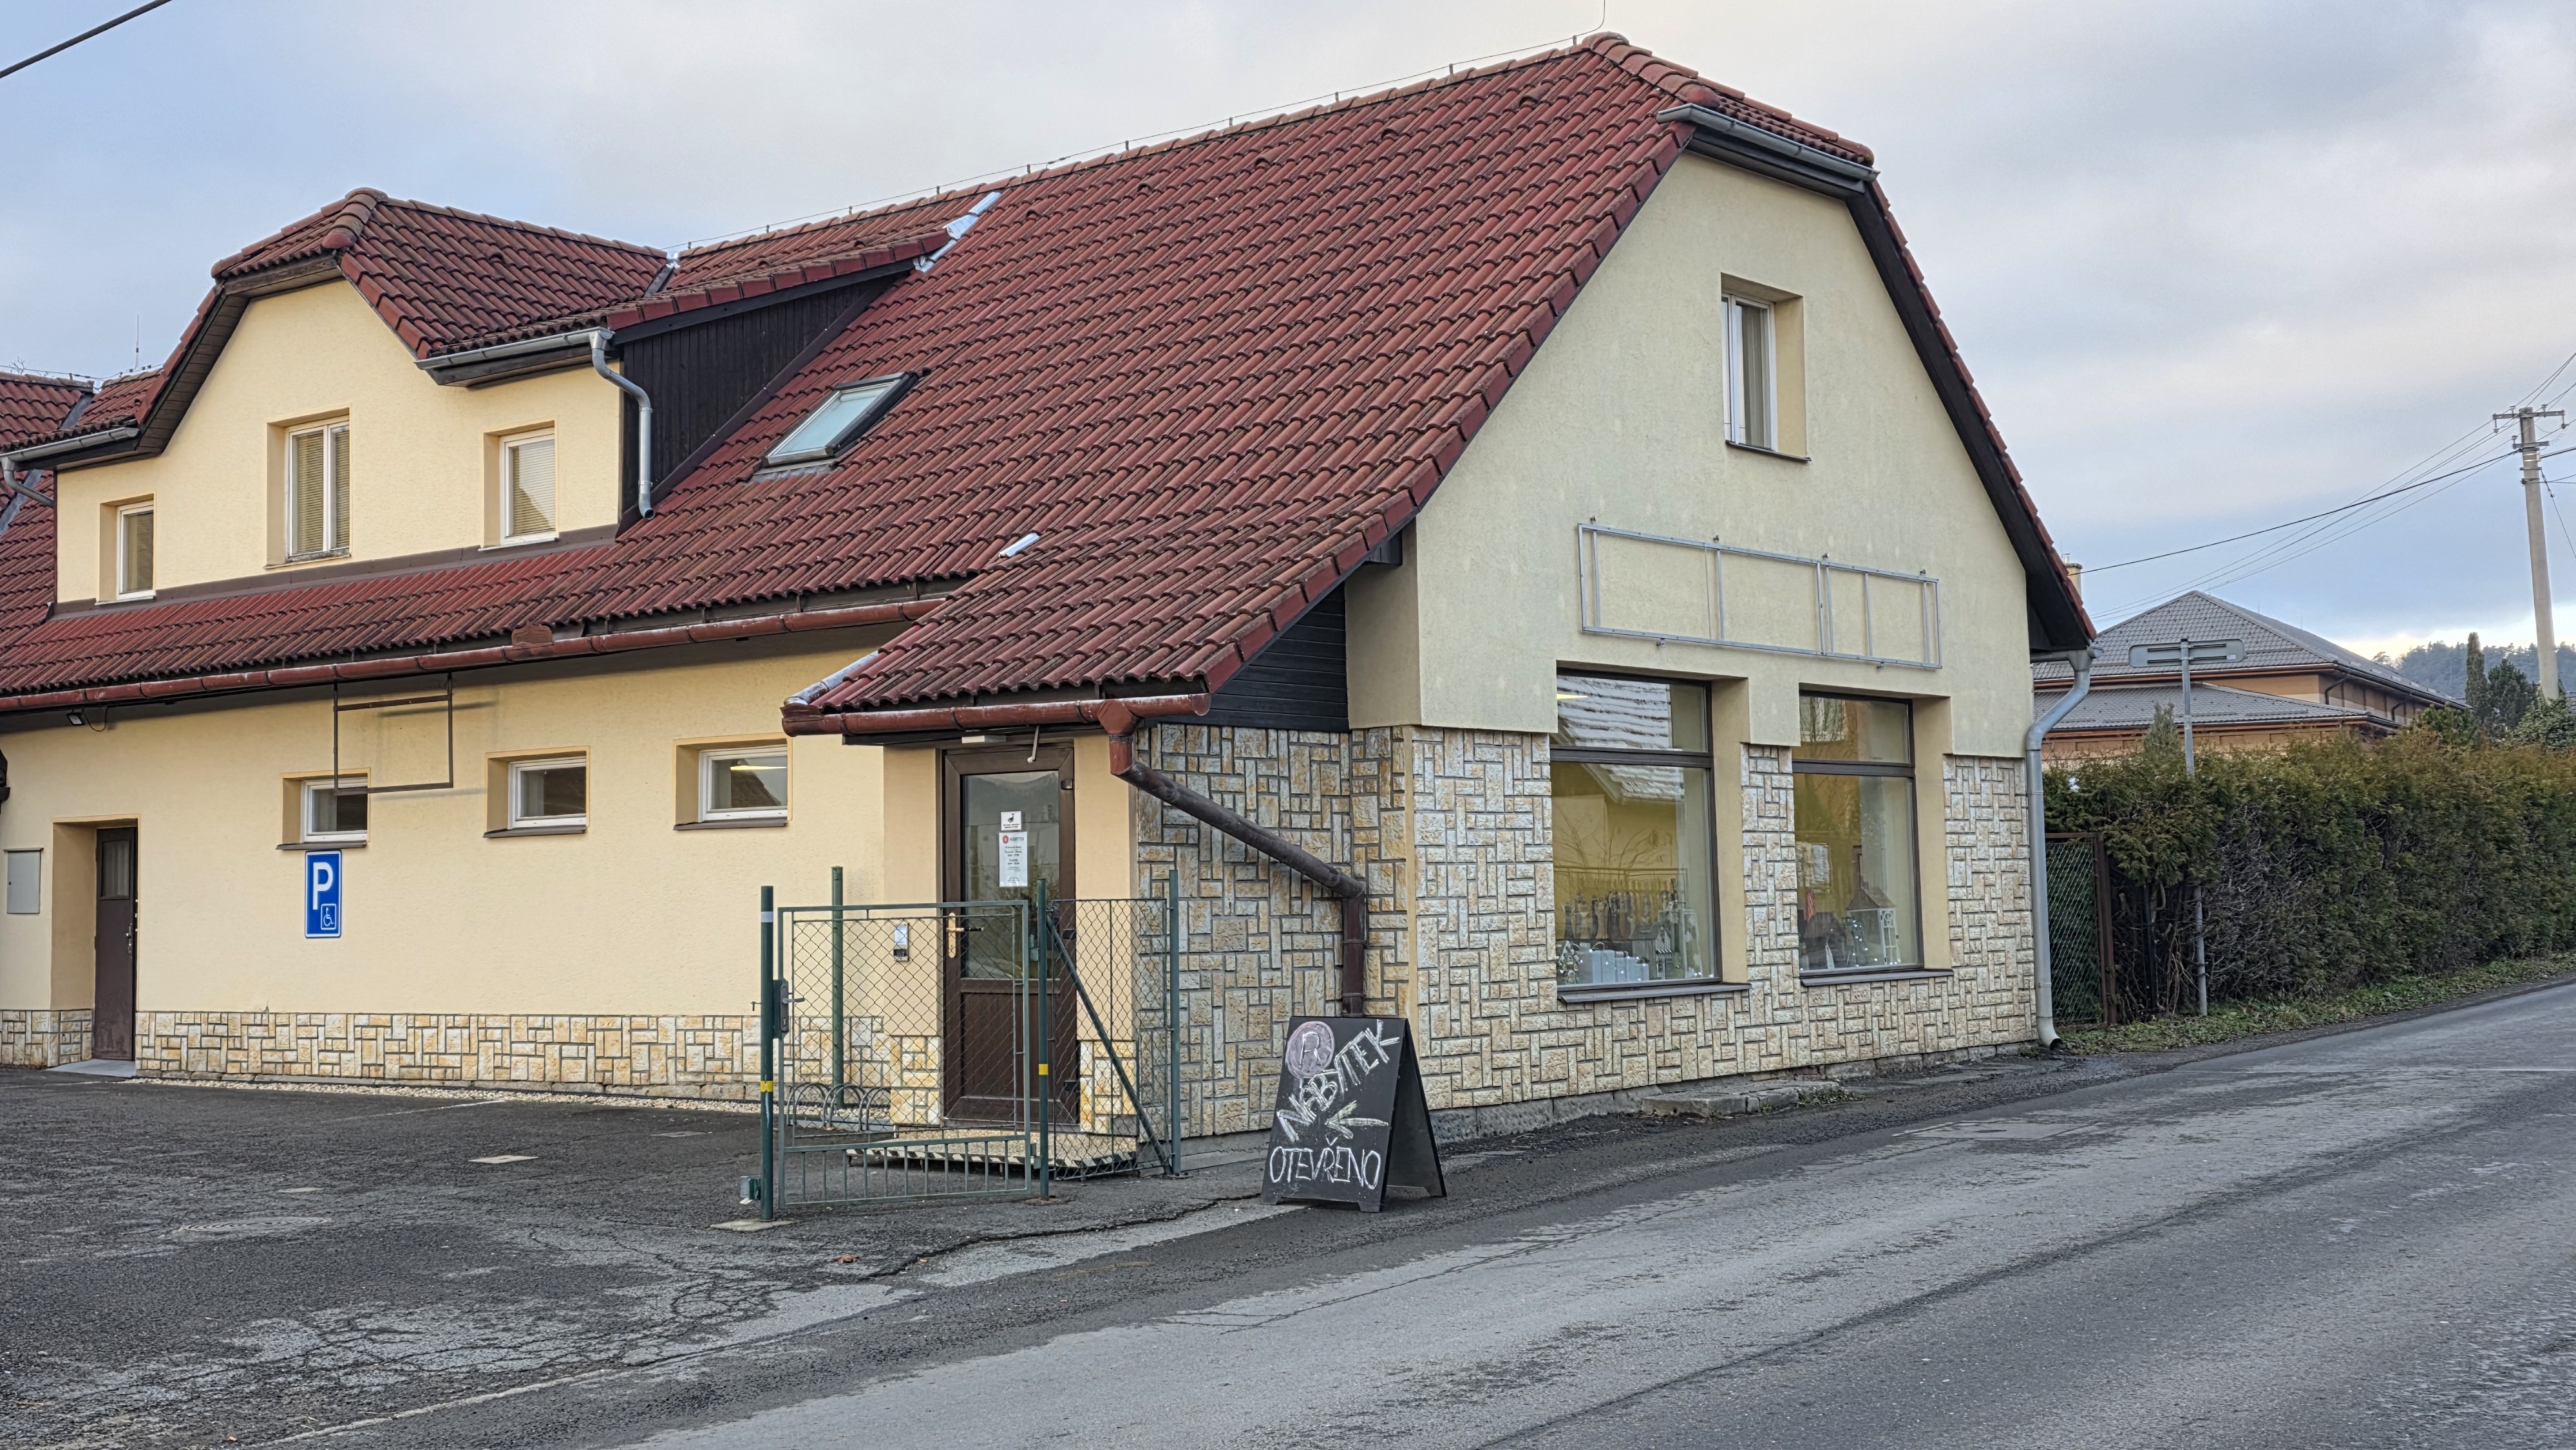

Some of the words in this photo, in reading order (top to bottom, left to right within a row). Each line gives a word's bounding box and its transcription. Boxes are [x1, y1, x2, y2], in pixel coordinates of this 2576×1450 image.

[312, 862, 334, 910] P
[1298, 1030, 1321, 1070] R
[1269, 1137, 1381, 1190] OTEVŘENO
